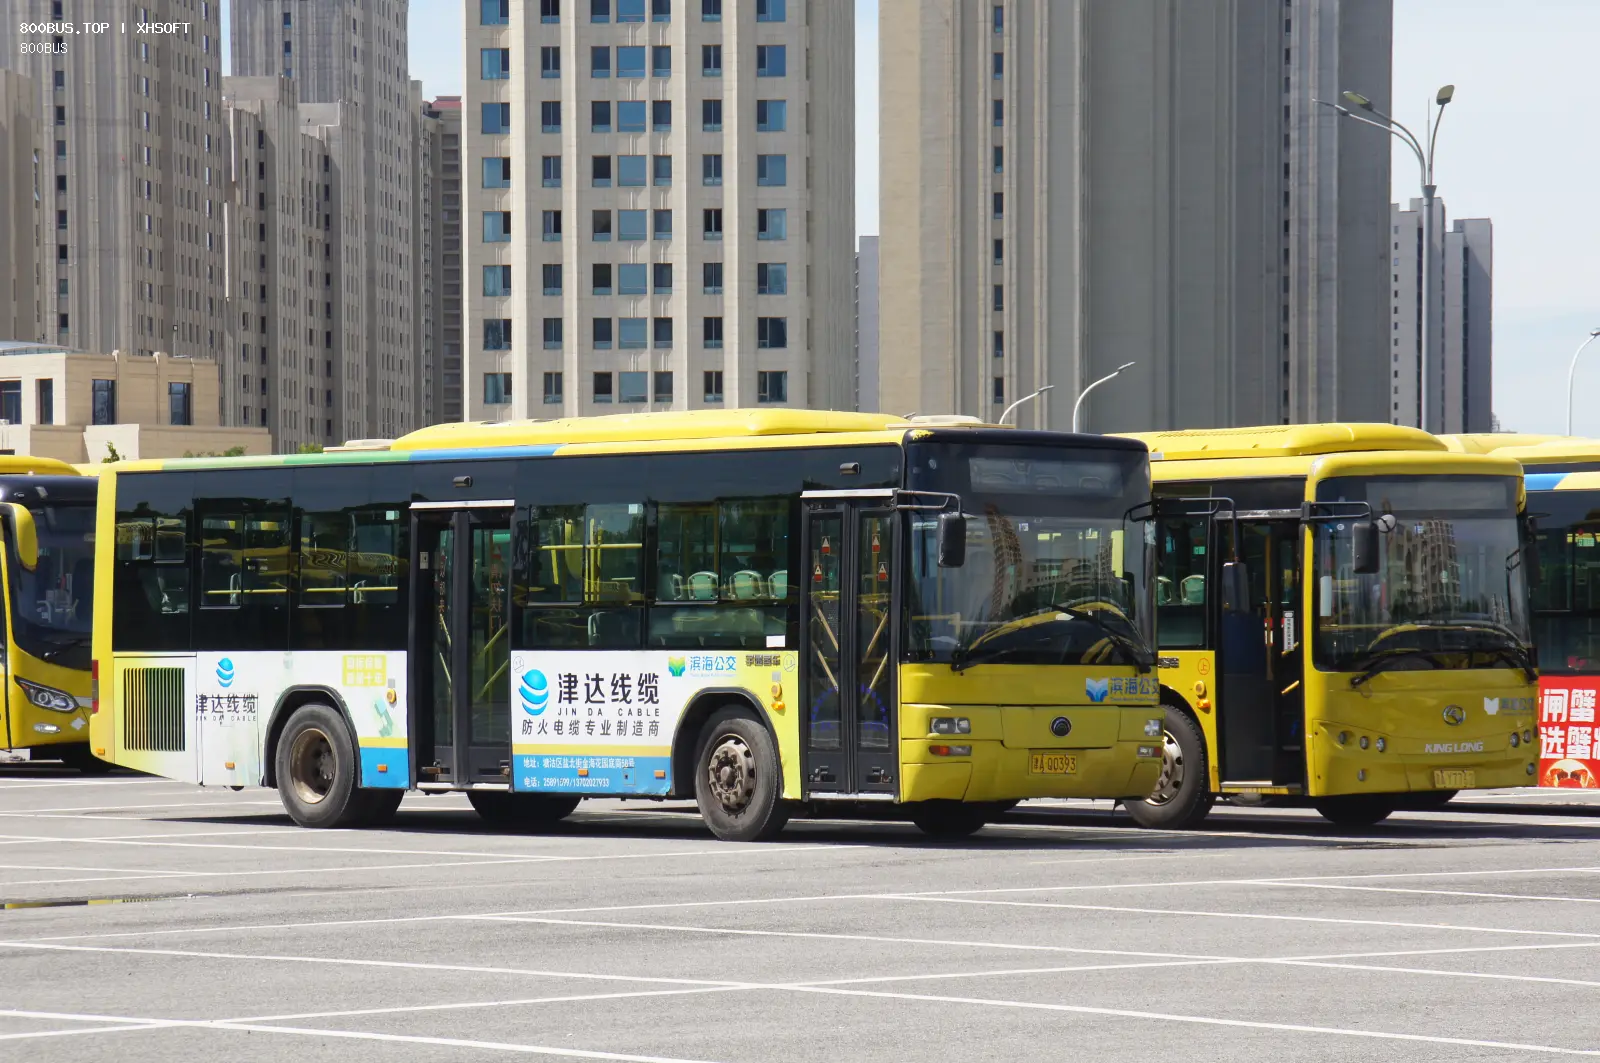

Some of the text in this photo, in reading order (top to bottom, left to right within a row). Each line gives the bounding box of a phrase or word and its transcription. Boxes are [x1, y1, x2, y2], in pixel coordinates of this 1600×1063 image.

[690, 655, 737, 671] 滨海公交
[557, 672, 660, 705] 津达线缆
[195, 693, 257, 714] 津达线缆
[557, 707, 661, 717] JIN DA CABLE
[1539, 688, 1597, 723] 闸蟹
[521, 718, 660, 738] 防火电缆专业制造商
[1424, 741, 1484, 753] KING LONG
